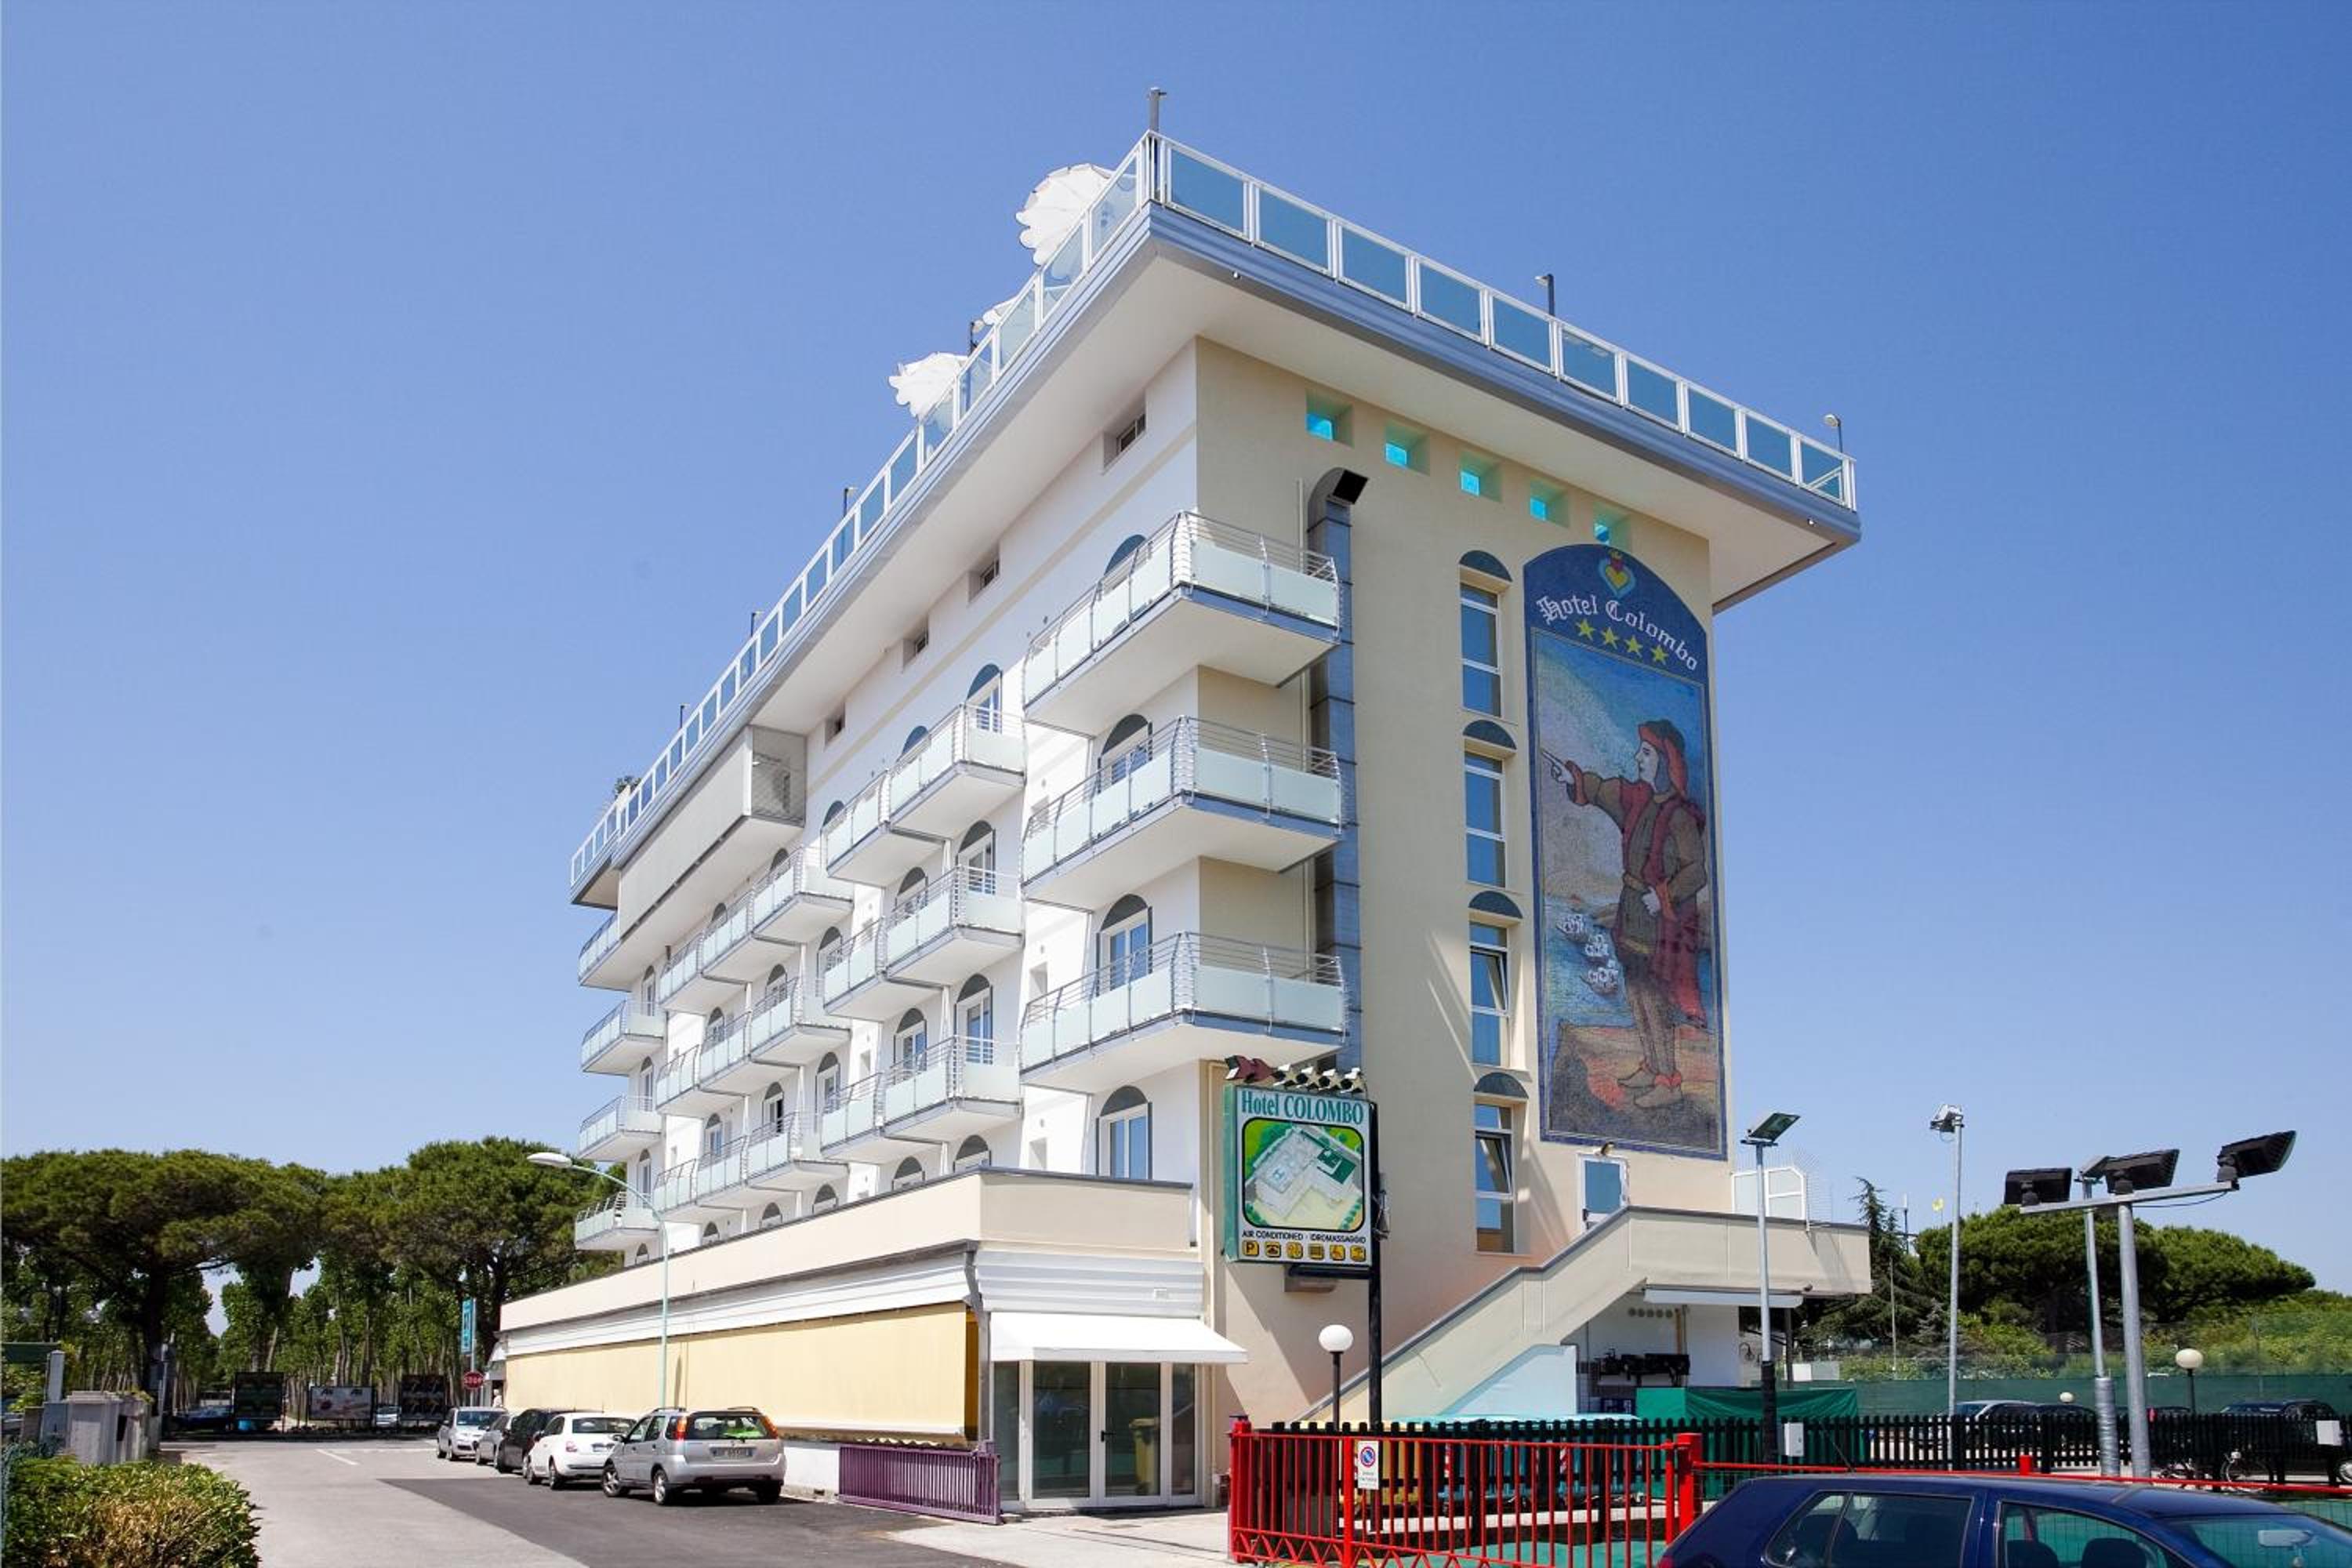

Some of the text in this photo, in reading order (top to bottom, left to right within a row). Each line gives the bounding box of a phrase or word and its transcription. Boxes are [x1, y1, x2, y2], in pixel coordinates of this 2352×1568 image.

[1536, 594, 1698, 672] Hotel Colombo
[1242, 1091, 1363, 1124] Hotel COLOMBO
[1256, 1231, 1304, 1240] CONDITIONED
